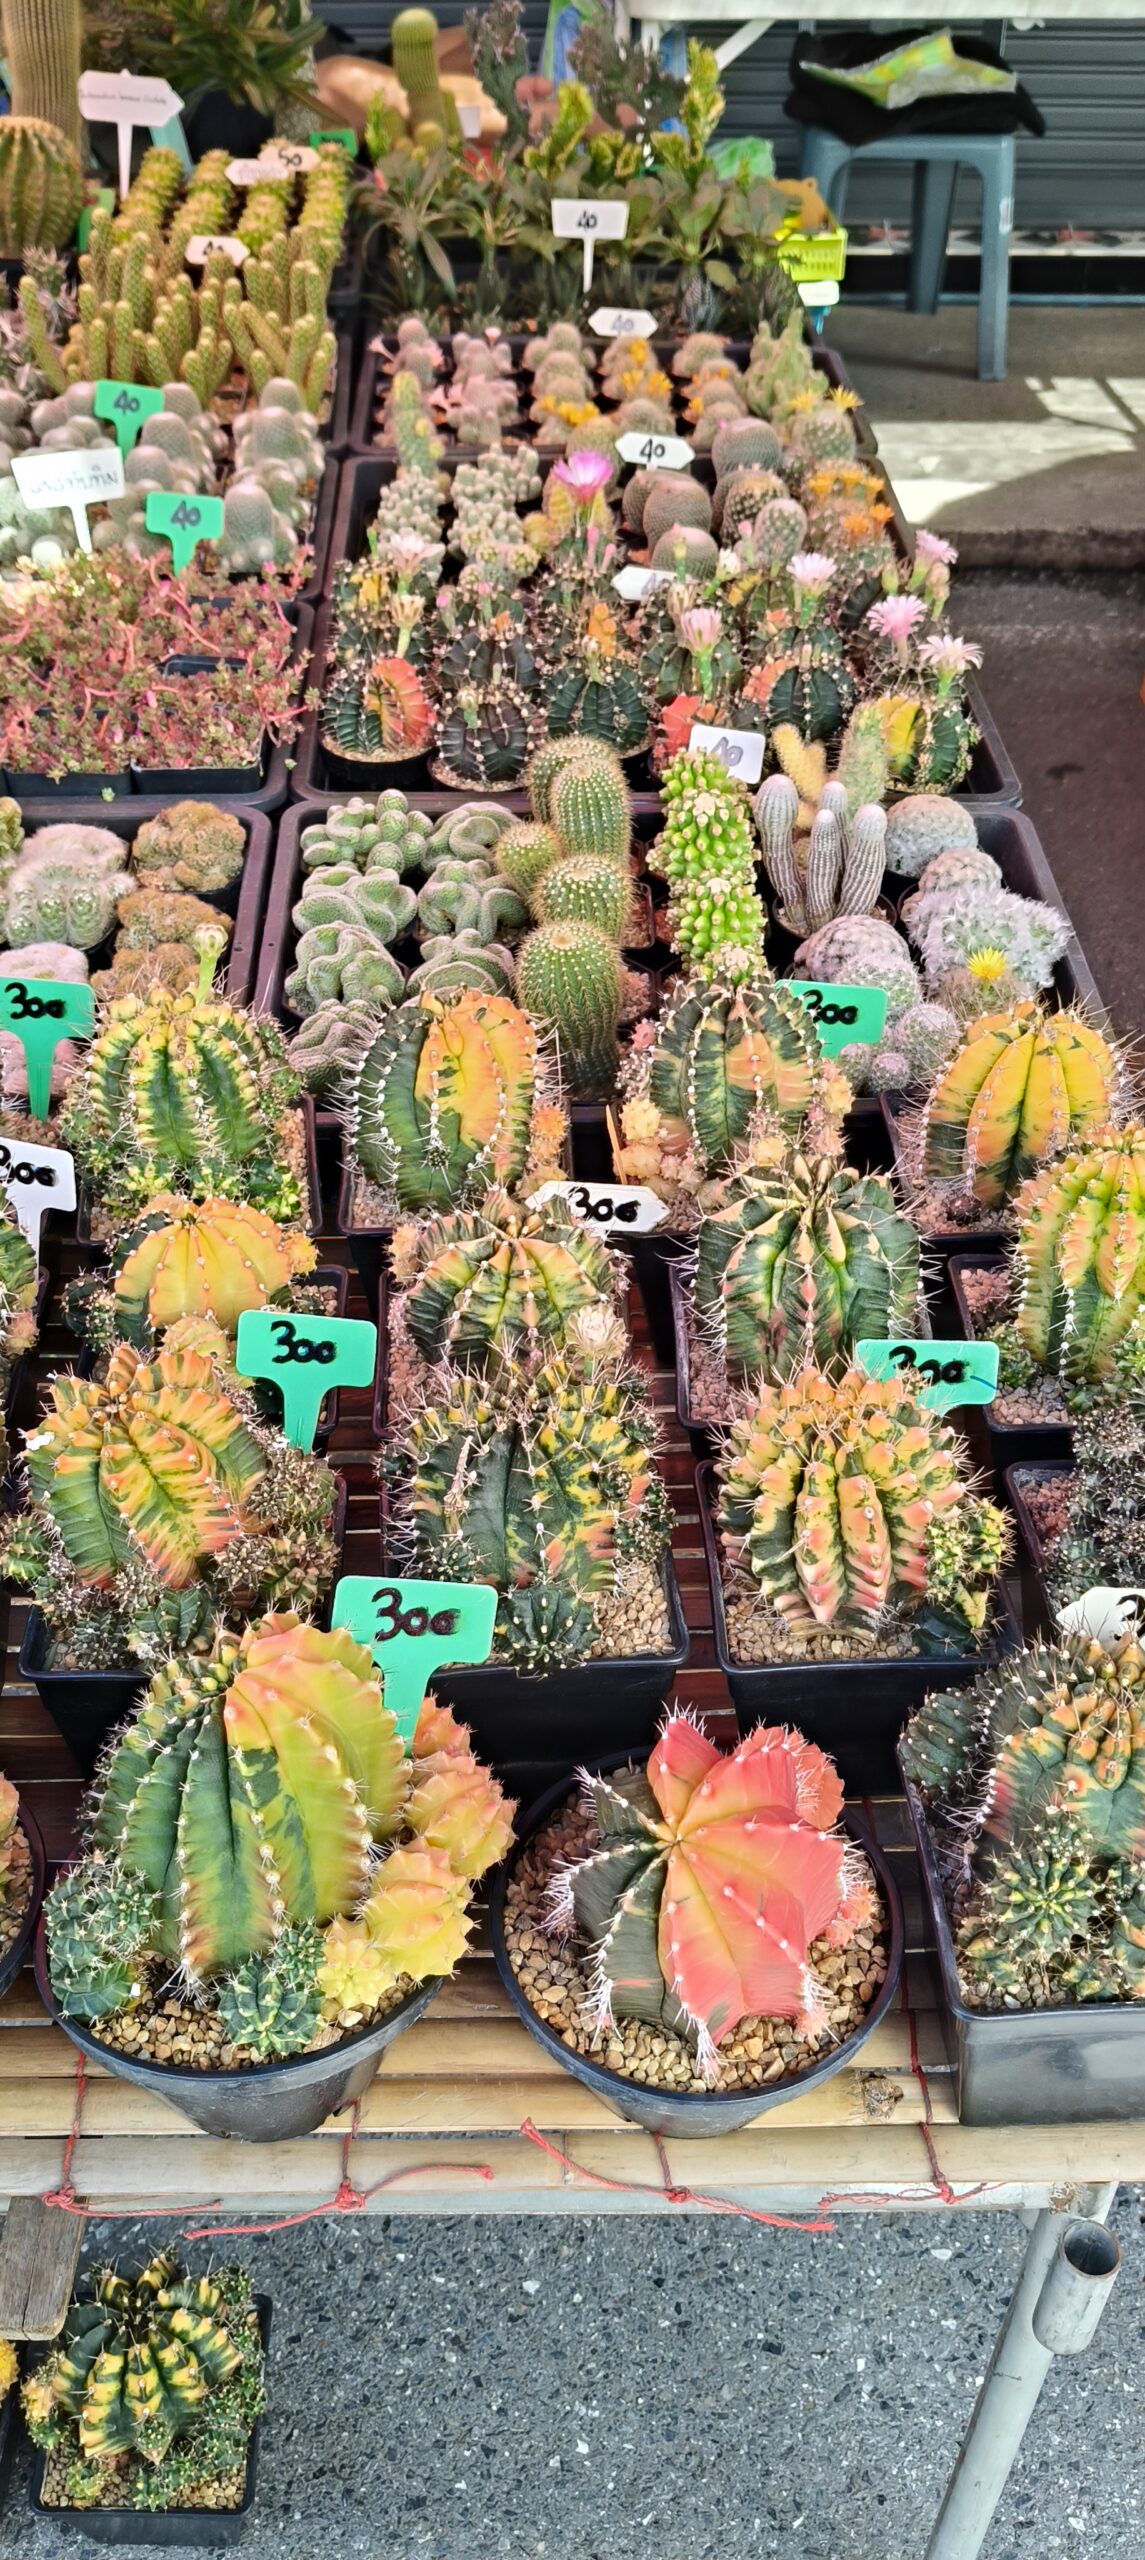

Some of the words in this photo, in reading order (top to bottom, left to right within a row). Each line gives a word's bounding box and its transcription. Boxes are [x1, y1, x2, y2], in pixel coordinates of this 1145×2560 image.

[278, 149, 302, 166] 50
[577, 210, 597, 230] 40
[612, 314, 634, 336] 40
[113, 389, 140, 414] 40
[640, 438, 666, 462] 40
[170, 500, 200, 531] 40
[4, 982, 66, 1019] 300
[271, 1320, 337, 1364] 300
[371, 1587, 460, 1642] 300
